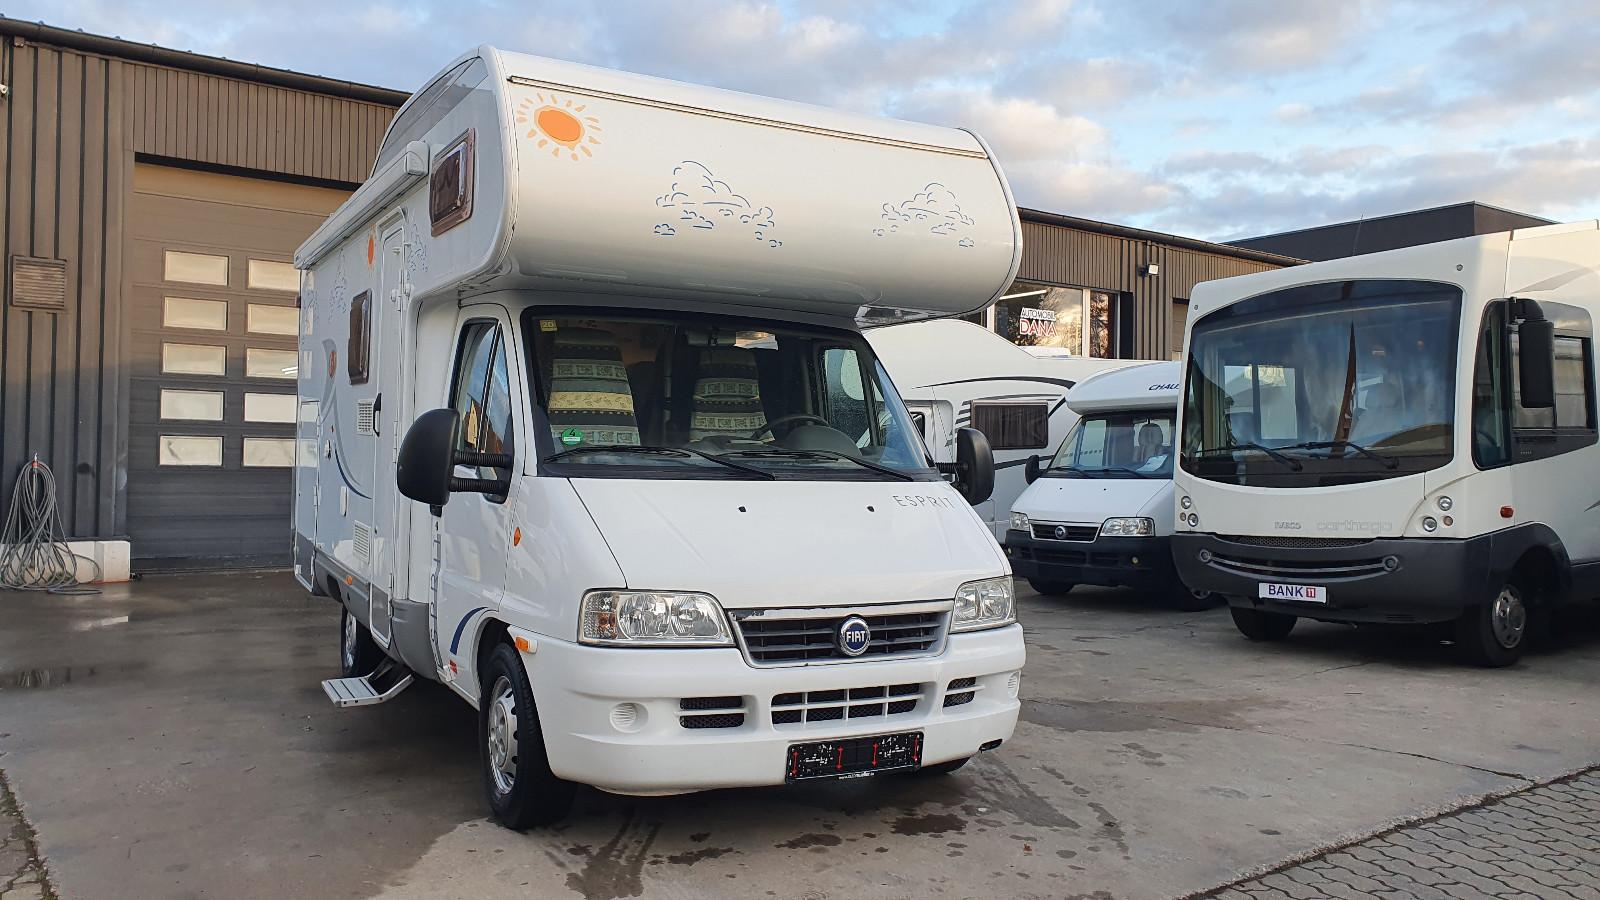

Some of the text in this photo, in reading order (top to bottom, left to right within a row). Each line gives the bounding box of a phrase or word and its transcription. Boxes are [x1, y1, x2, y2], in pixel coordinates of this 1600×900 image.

[1020, 319, 1057, 336] DANA
[892, 495, 955, 509] ESPRIT
[1268, 584, 1303, 598] BANK
[846, 630, 866, 643] FIAT
